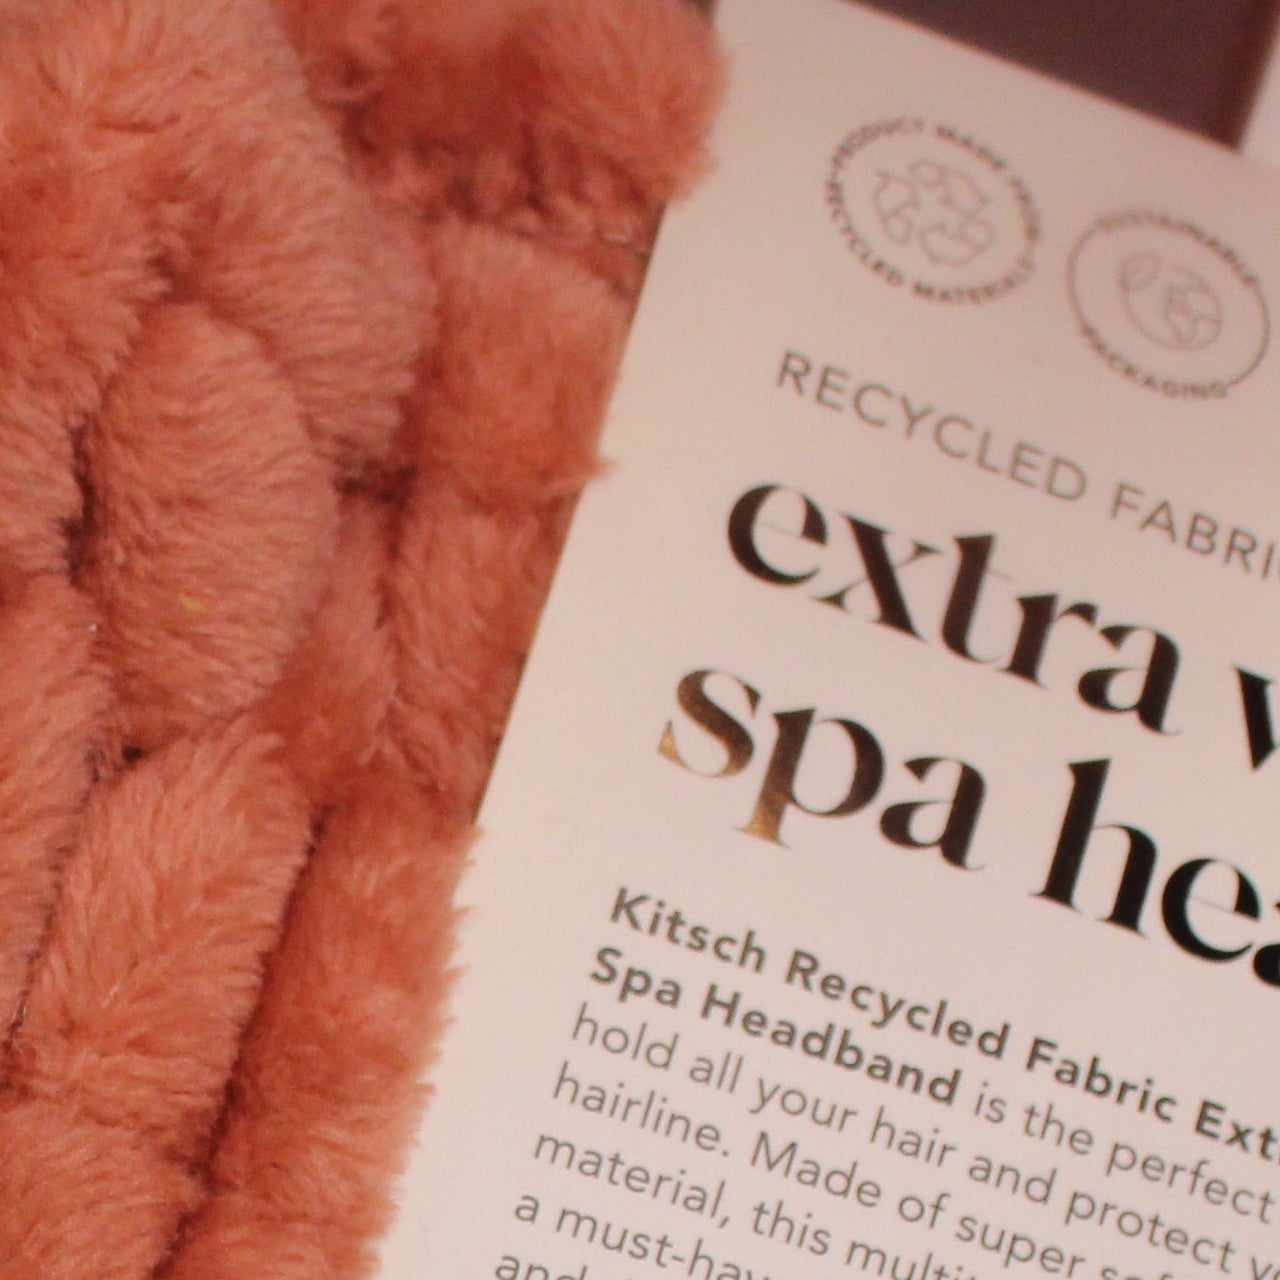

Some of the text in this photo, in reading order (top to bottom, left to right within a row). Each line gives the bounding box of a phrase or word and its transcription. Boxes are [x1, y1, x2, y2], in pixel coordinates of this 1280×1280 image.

[776, 351, 1279, 580] RECYCLED FABRI
[726, 482, 1182, 735] extra
[656, 668, 986, 872] spa
[572, 1002, 1236, 1274] hold all your hair and protect
[591, 946, 1276, 1225] Spa Headband is the perfect
[609, 886, 1279, 1162] Kitsch Recycled Fabric Ext
[514, 1194, 540, 1223] a
[533, 1133, 731, 1230] material,
[751, 1202, 831, 1256] this
[552, 1062, 731, 1159] hairline.
[750, 1131, 882, 1208] Made
[897, 1189, 947, 1231] of
[956, 1214, 1086, 1280] super
